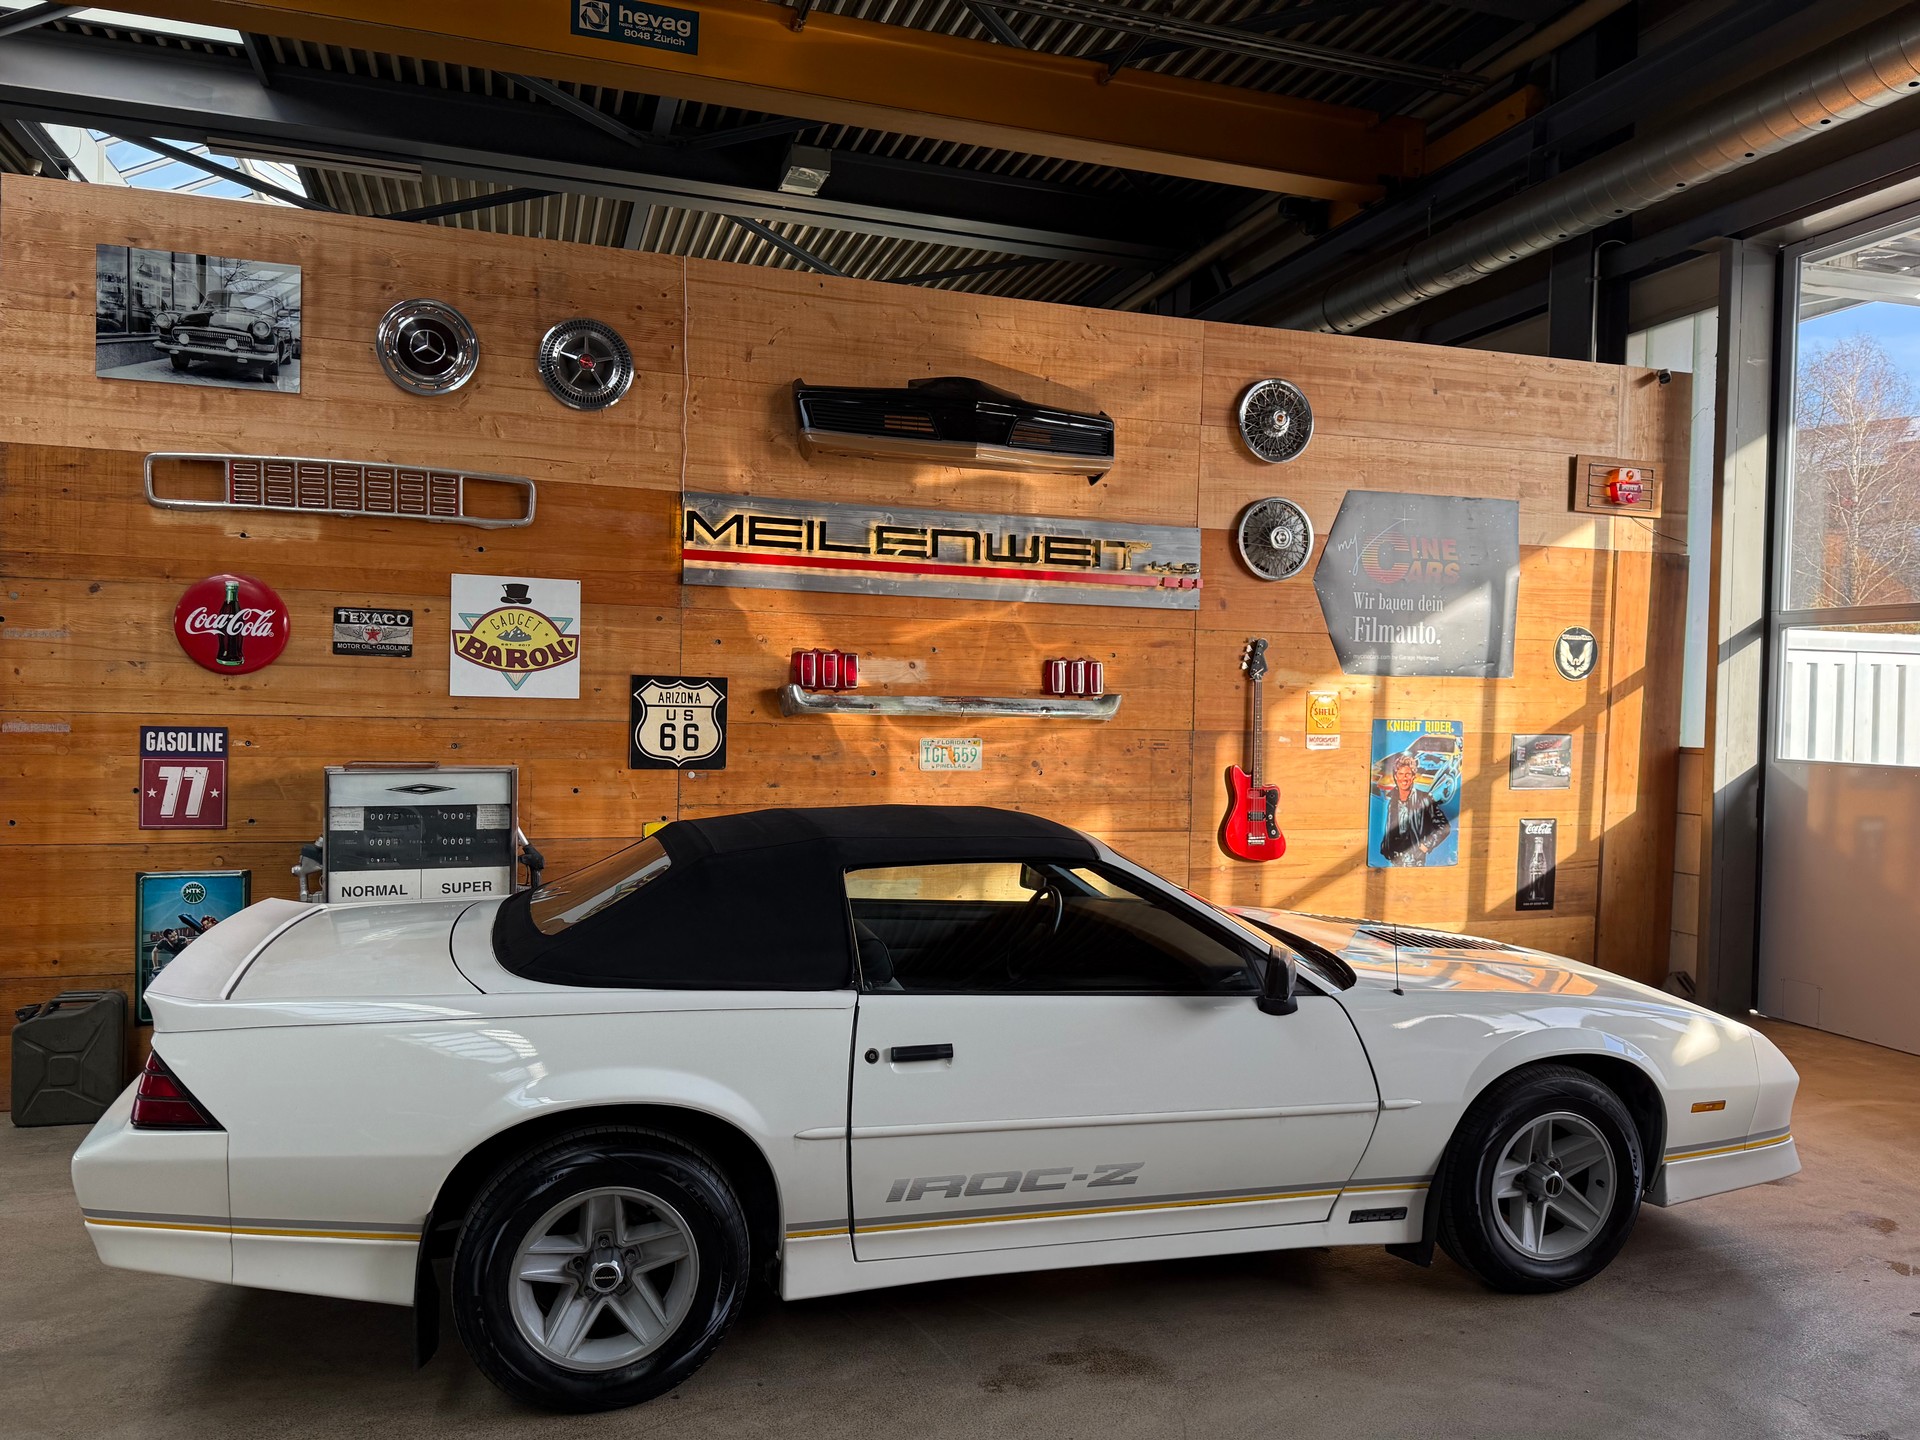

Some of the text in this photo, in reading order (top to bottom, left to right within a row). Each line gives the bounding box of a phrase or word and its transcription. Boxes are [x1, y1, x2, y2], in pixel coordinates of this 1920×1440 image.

[619, 5, 691, 37] hevag
[624, 29, 686, 46] 8048 Zürich
[686, 510, 1152, 571] MEILENWEIT
[1353, 591, 1444, 612] Wir bauen dein
[185, 607, 276, 637] Coca-Cola
[338, 611, 410, 625] TEXACO
[490, 612, 543, 632] GADGET
[1353, 616, 1441, 645] Filmauto.
[459, 635, 574, 669] BARON
[658, 691, 702, 704] ARIZONA
[1314, 708, 1335, 716] SHELL
[660, 723, 699, 751] 66
[1387, 720, 1422, 733] KNIGHT
[146, 731, 223, 752] GASOLINE
[953, 747, 978, 763] 559
[158, 766, 209, 818] 77
[341, 881, 492, 897] NORMAL SUPER
[886, 1161, 1145, 1203] IROC-Z
